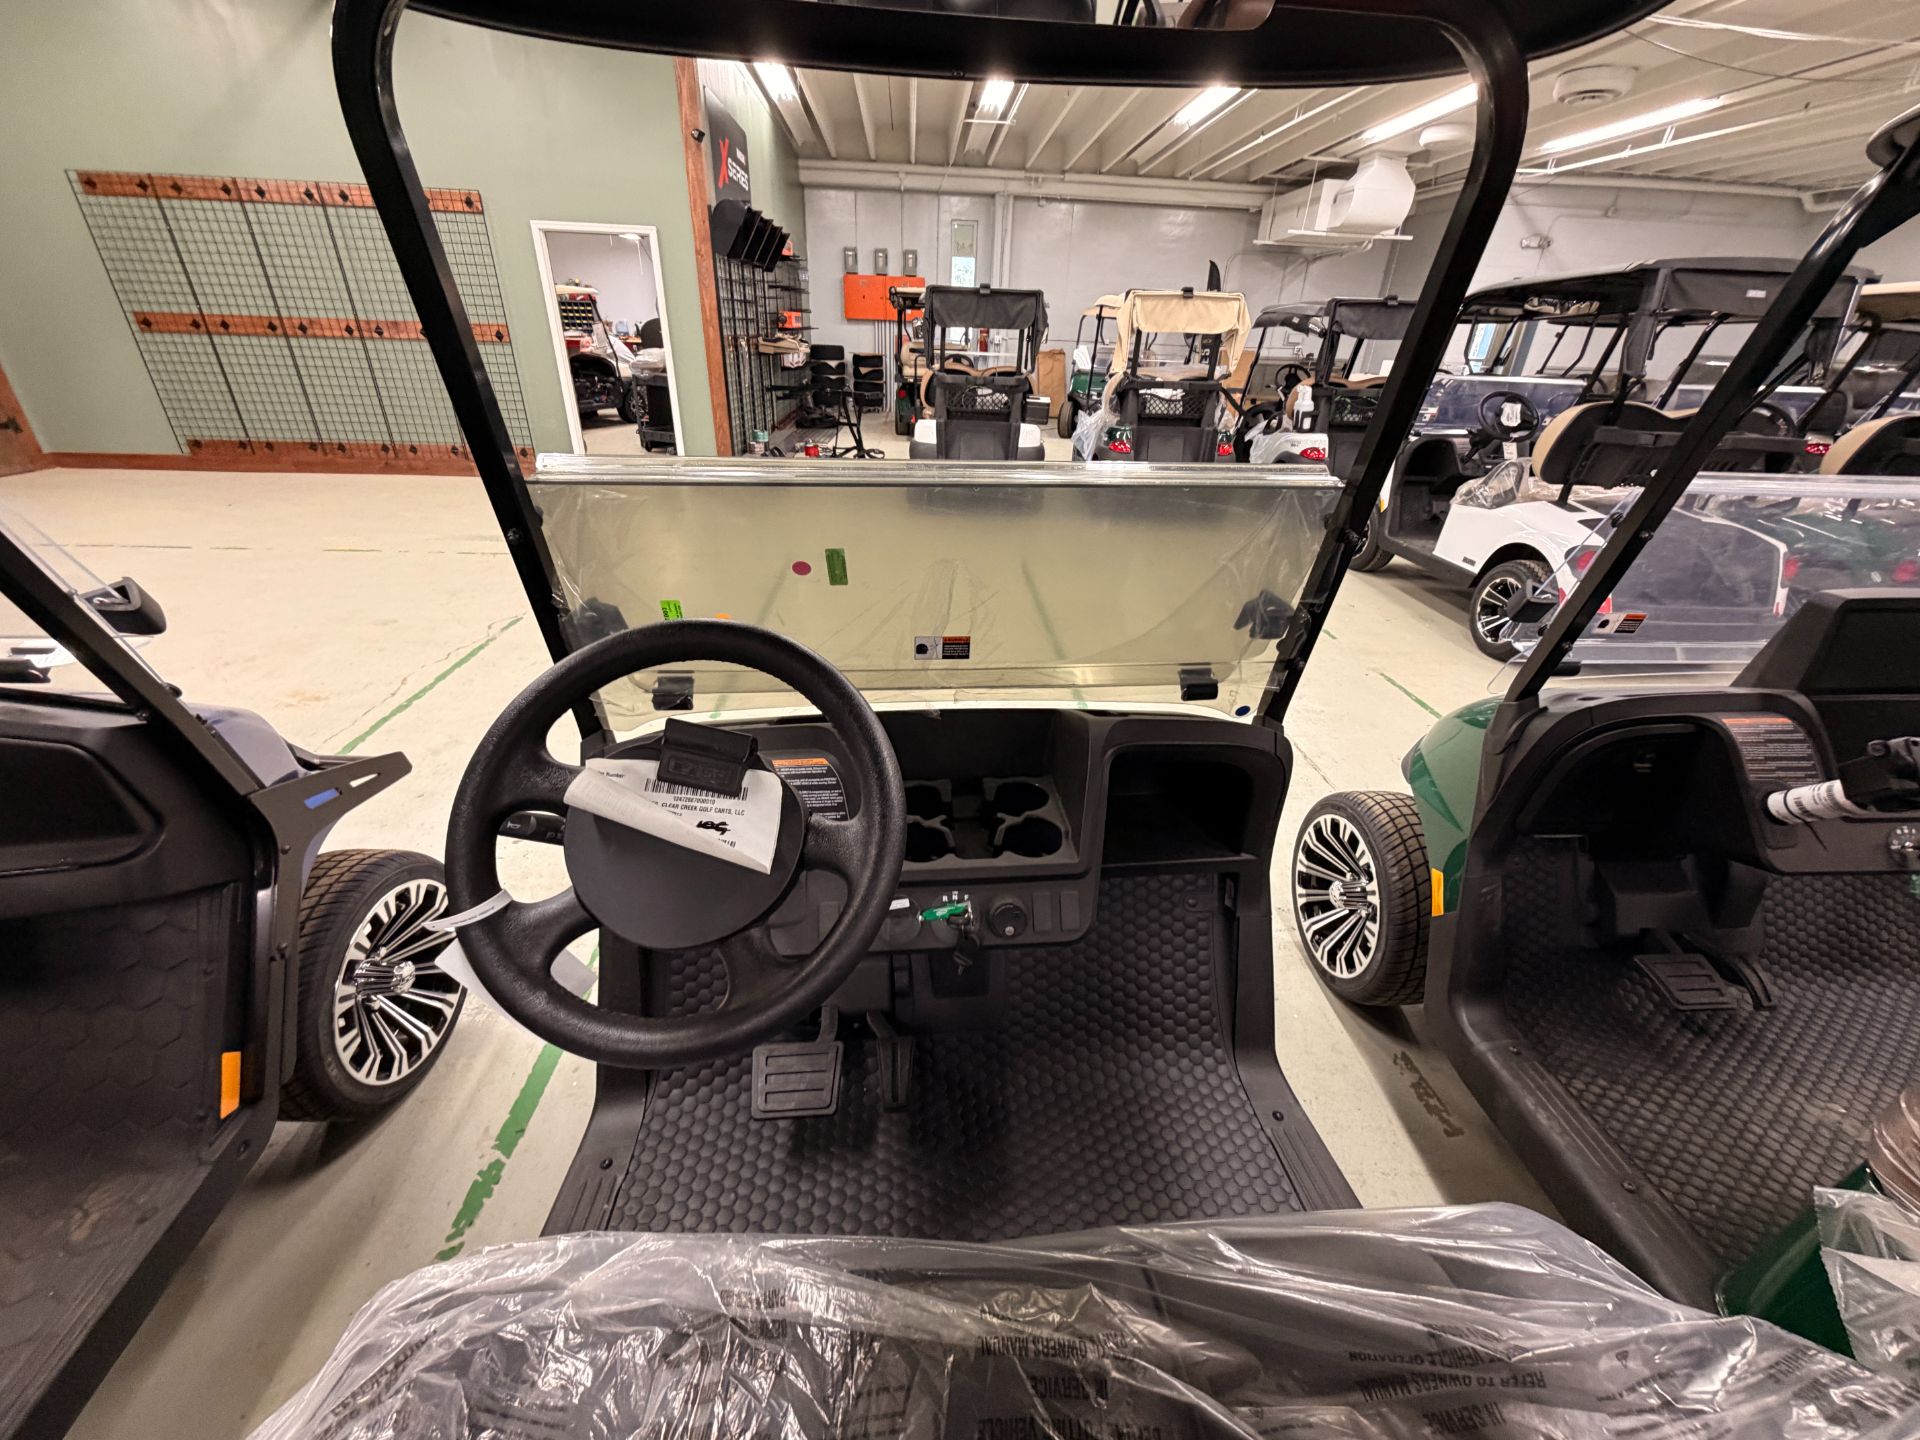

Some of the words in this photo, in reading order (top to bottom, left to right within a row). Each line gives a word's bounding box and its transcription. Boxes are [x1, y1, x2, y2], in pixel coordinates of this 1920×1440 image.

[727, 157, 749, 192] SERIES
[978, 1335, 1029, 1357] MANUAL
[1033, 1336, 1088, 1359] OWNERS
[1355, 1375, 1412, 1402] MANUAL
[1409, 1372, 1472, 1394] OWNERS
[1477, 1376, 1496, 1387] TO
[1500, 1370, 1547, 1388] REFER
[1422, 1404, 1487, 1434] SERVICE
[1484, 1401, 1506, 1425] IN
